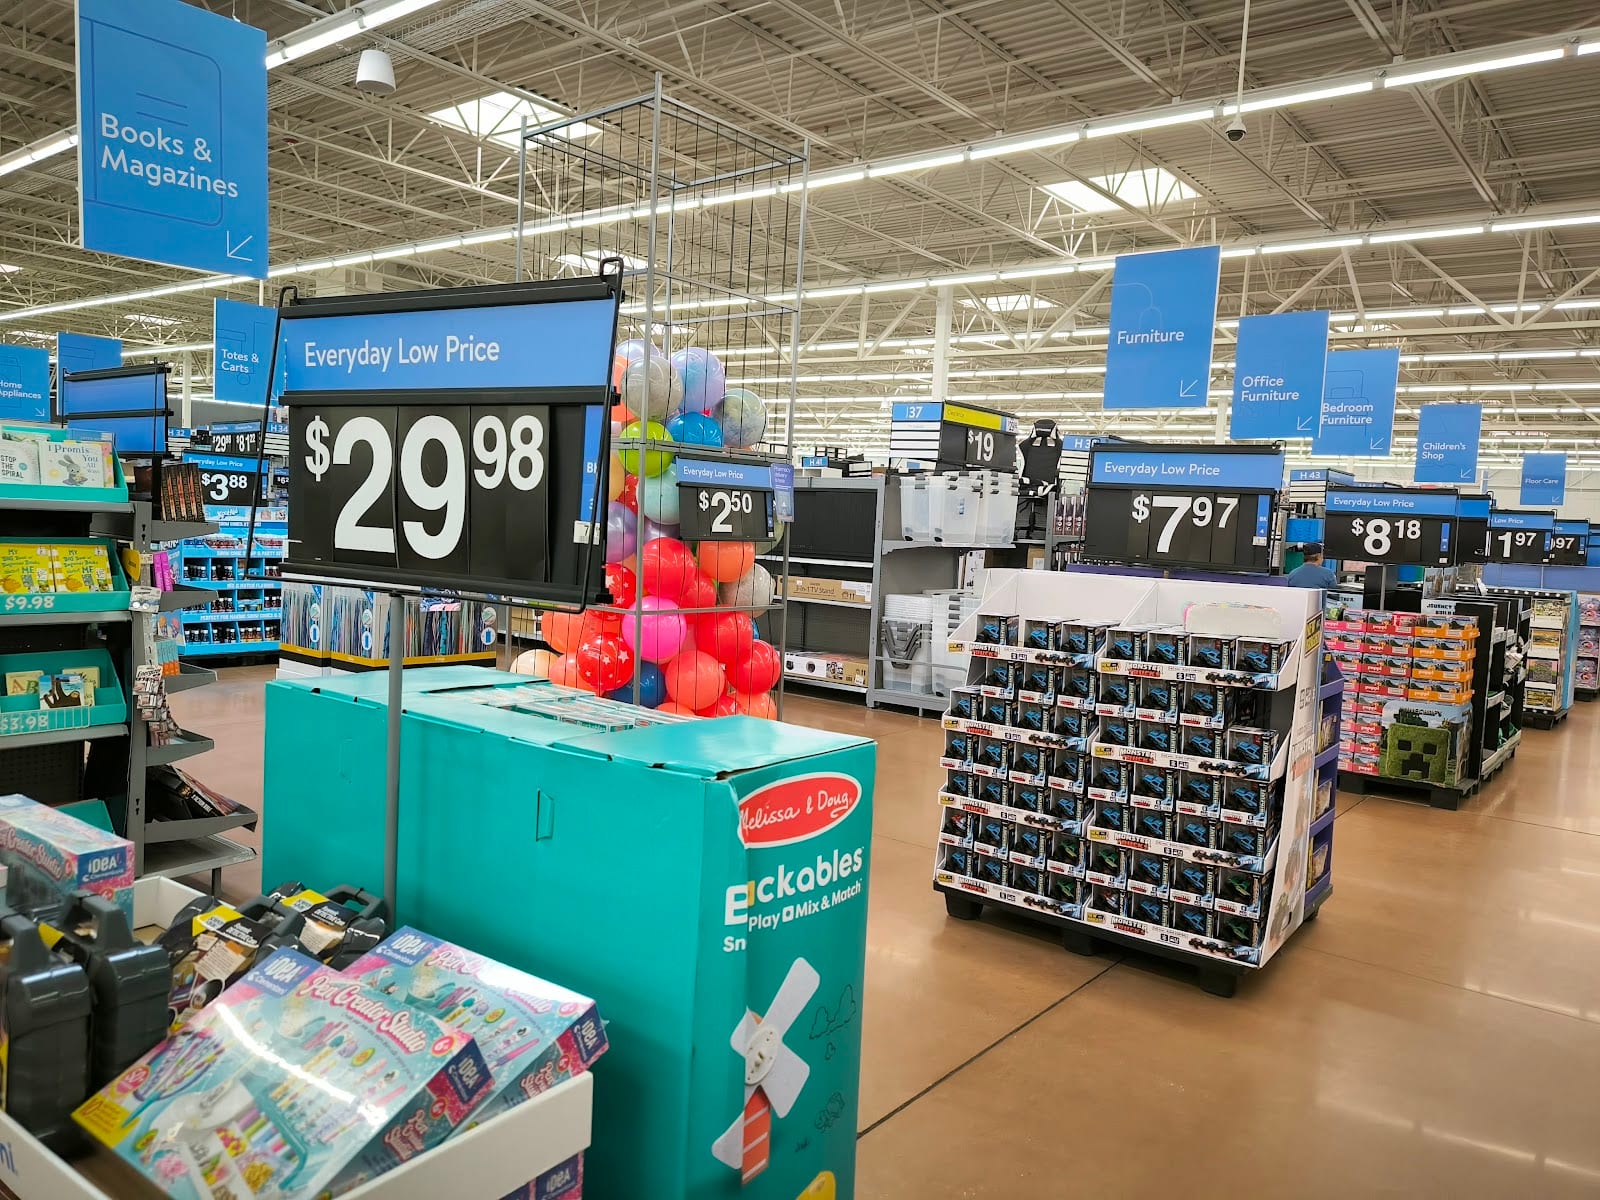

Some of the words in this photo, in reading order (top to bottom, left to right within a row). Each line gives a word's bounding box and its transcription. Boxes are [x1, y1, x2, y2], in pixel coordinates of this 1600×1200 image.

[101, 112, 184, 156] Books
[193, 137, 212, 163] &
[101, 145, 239, 198] Magazines
[1117, 329, 1185, 345] Furniture
[221, 349, 248, 362] Totes
[251, 353, 259, 363] &
[305, 340, 393, 373] Everyday
[399, 338, 438, 364] Low
[446, 334, 500, 362] Price
[221, 361, 249, 374] Carts
[1242, 376, 1284, 388] Office
[1241, 391, 1299, 402] Furniture
[1322, 403, 1374, 413] Bedroom
[1321, 415, 1373, 425] Furniture
[278, 424, 288, 432] 34
[968, 429, 994, 462] $19
[1074, 439, 1083, 449] H
[1422, 442, 1466, 451] Children's
[1, 455, 17, 463] STOP
[189, 457, 215, 466] Everyday
[1422, 451, 1444, 461] Shop
[2, 470, 24, 479] SPIRAL
[683, 466, 713, 479] Everyday
[714, 469, 728, 478] Low
[729, 470, 743, 480] Price
[1104, 462, 1158, 477] Everyday
[1161, 464, 1185, 475] Low
[1189, 464, 1221, 476] Price
[1333, 497, 1370, 507] Everyday
[1393, 499, 1415, 508] Price
[5, 595, 55, 610] $9.98
[817, 790, 850, 819] Doug
[796, 900, 819, 919] Mix
[821, 896, 831, 910] &
[832, 882, 861, 906] Match
[749, 911, 780, 932] Play
[298, 975, 337, 1000] Pen
[333, 985, 389, 1024] Creator
[380, 1011, 427, 1052] Studio
